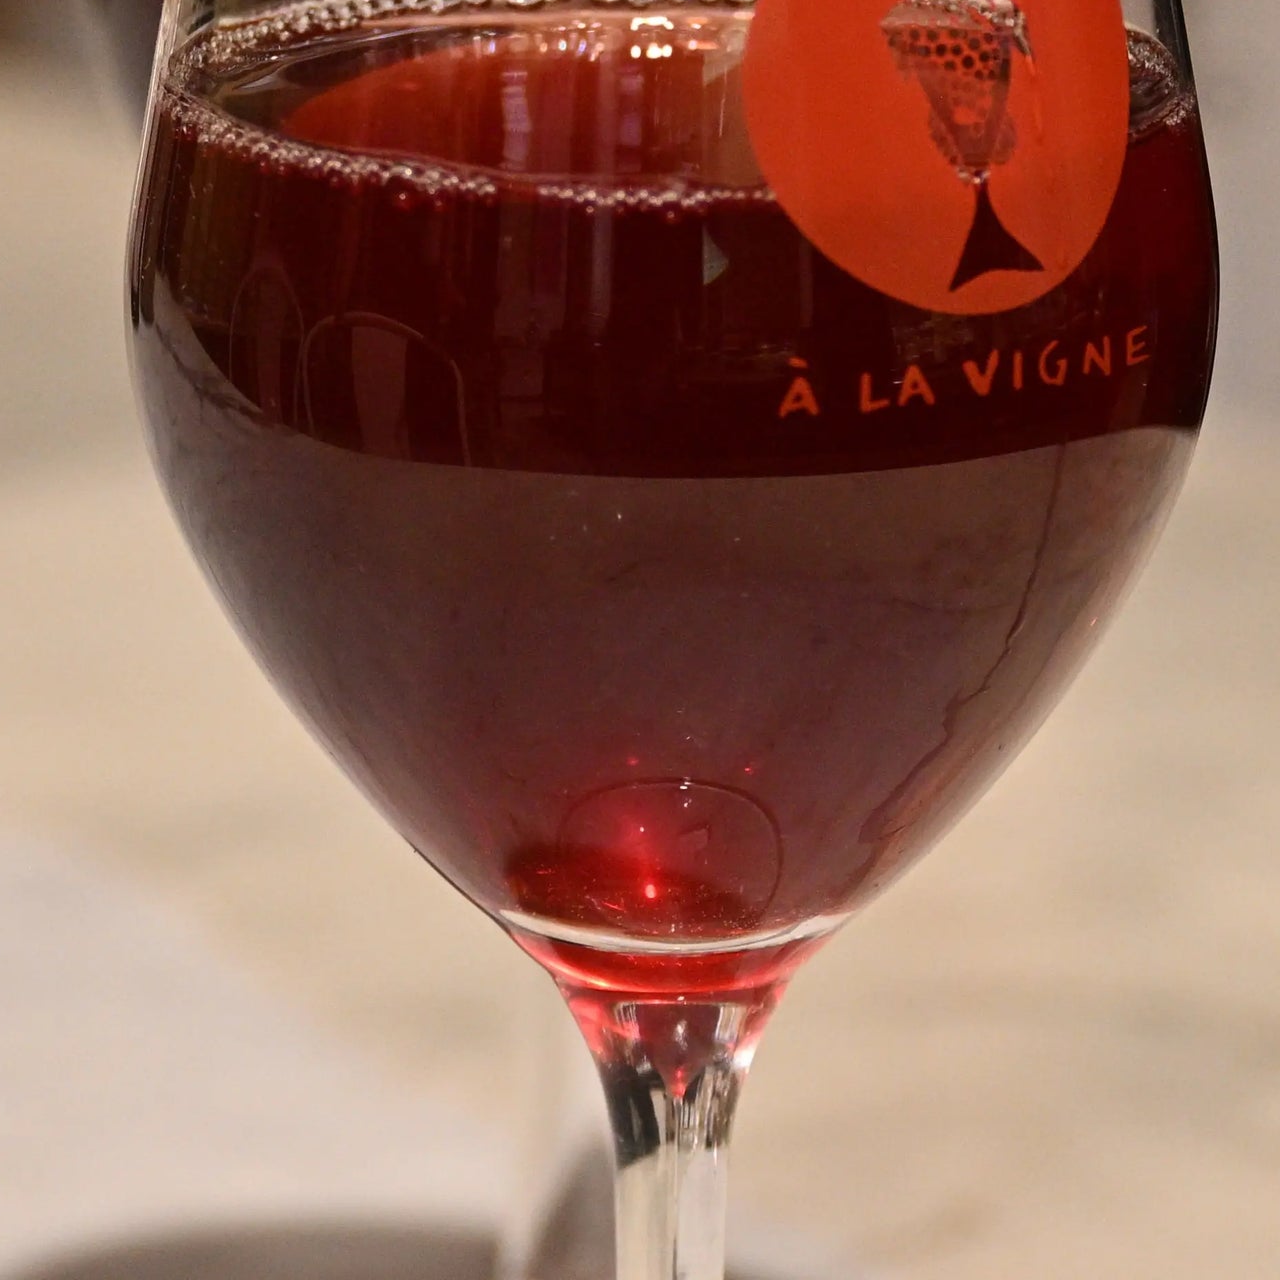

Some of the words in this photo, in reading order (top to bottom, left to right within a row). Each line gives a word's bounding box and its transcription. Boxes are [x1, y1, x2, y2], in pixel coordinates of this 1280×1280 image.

[778, 357, 819, 418] À
[859, 364, 936, 414] LA
[962, 325, 1149, 397] VIGNE
